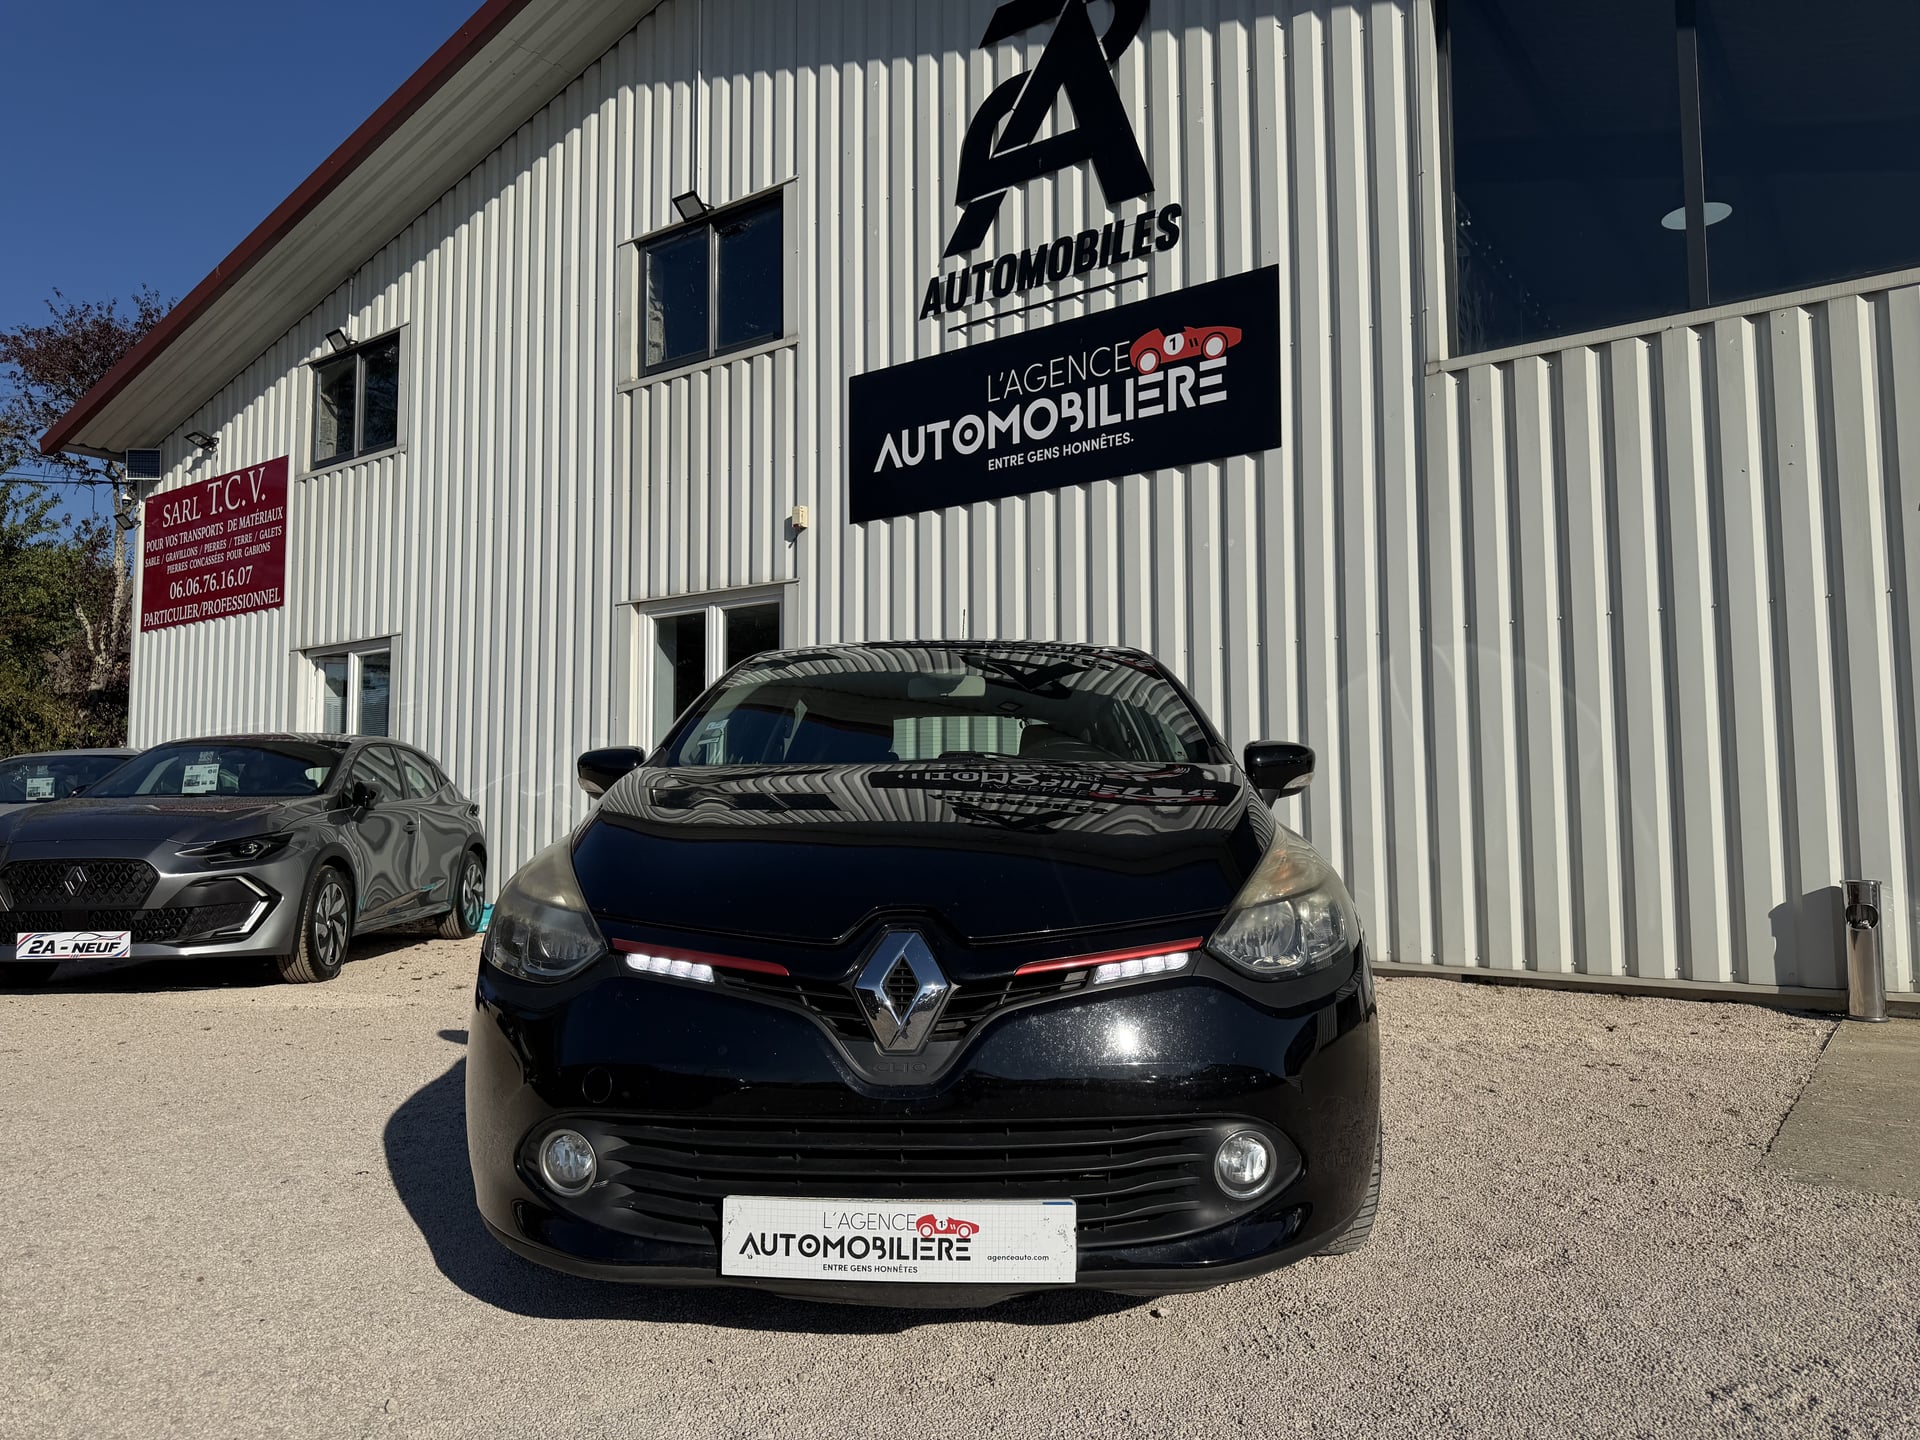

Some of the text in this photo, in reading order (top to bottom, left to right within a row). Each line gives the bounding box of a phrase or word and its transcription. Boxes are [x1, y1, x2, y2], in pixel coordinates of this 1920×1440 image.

[919, 203, 1182, 320] AUTOMOBILES
[988, 340, 1130, 402] L'AGENCE
[988, 432, 1135, 471] ENTRE GENS HONNÊTES.
[146, 506, 284, 553] POUR VOS TRANSPORTS DE MATÉRIAUX
[163, 496, 201, 528] SARL
[145, 556, 160, 568] SABLE
[165, 546, 198, 563] GRAVILLONS
[204, 539, 227, 554] PIERRES
[234, 532, 253, 547] TERRE
[259, 525, 283, 541] GALETS
[167, 541, 271, 575] PIERRES CONCASSÉES POUR GABIONS
[169, 565, 253, 600] 06.06.76.16.07
[143, 587, 281, 627] PARTICULIER/PROFESSIONNEL
[28, 940, 56, 954] 2A
[71, 942, 121, 953] NEUF
[823, 1212, 917, 1231] L'AGENCE
[823, 1263, 918, 1274] ENTRE GENS HONNÊTES
[986, 1254, 1050, 1263] agenceauto.com
